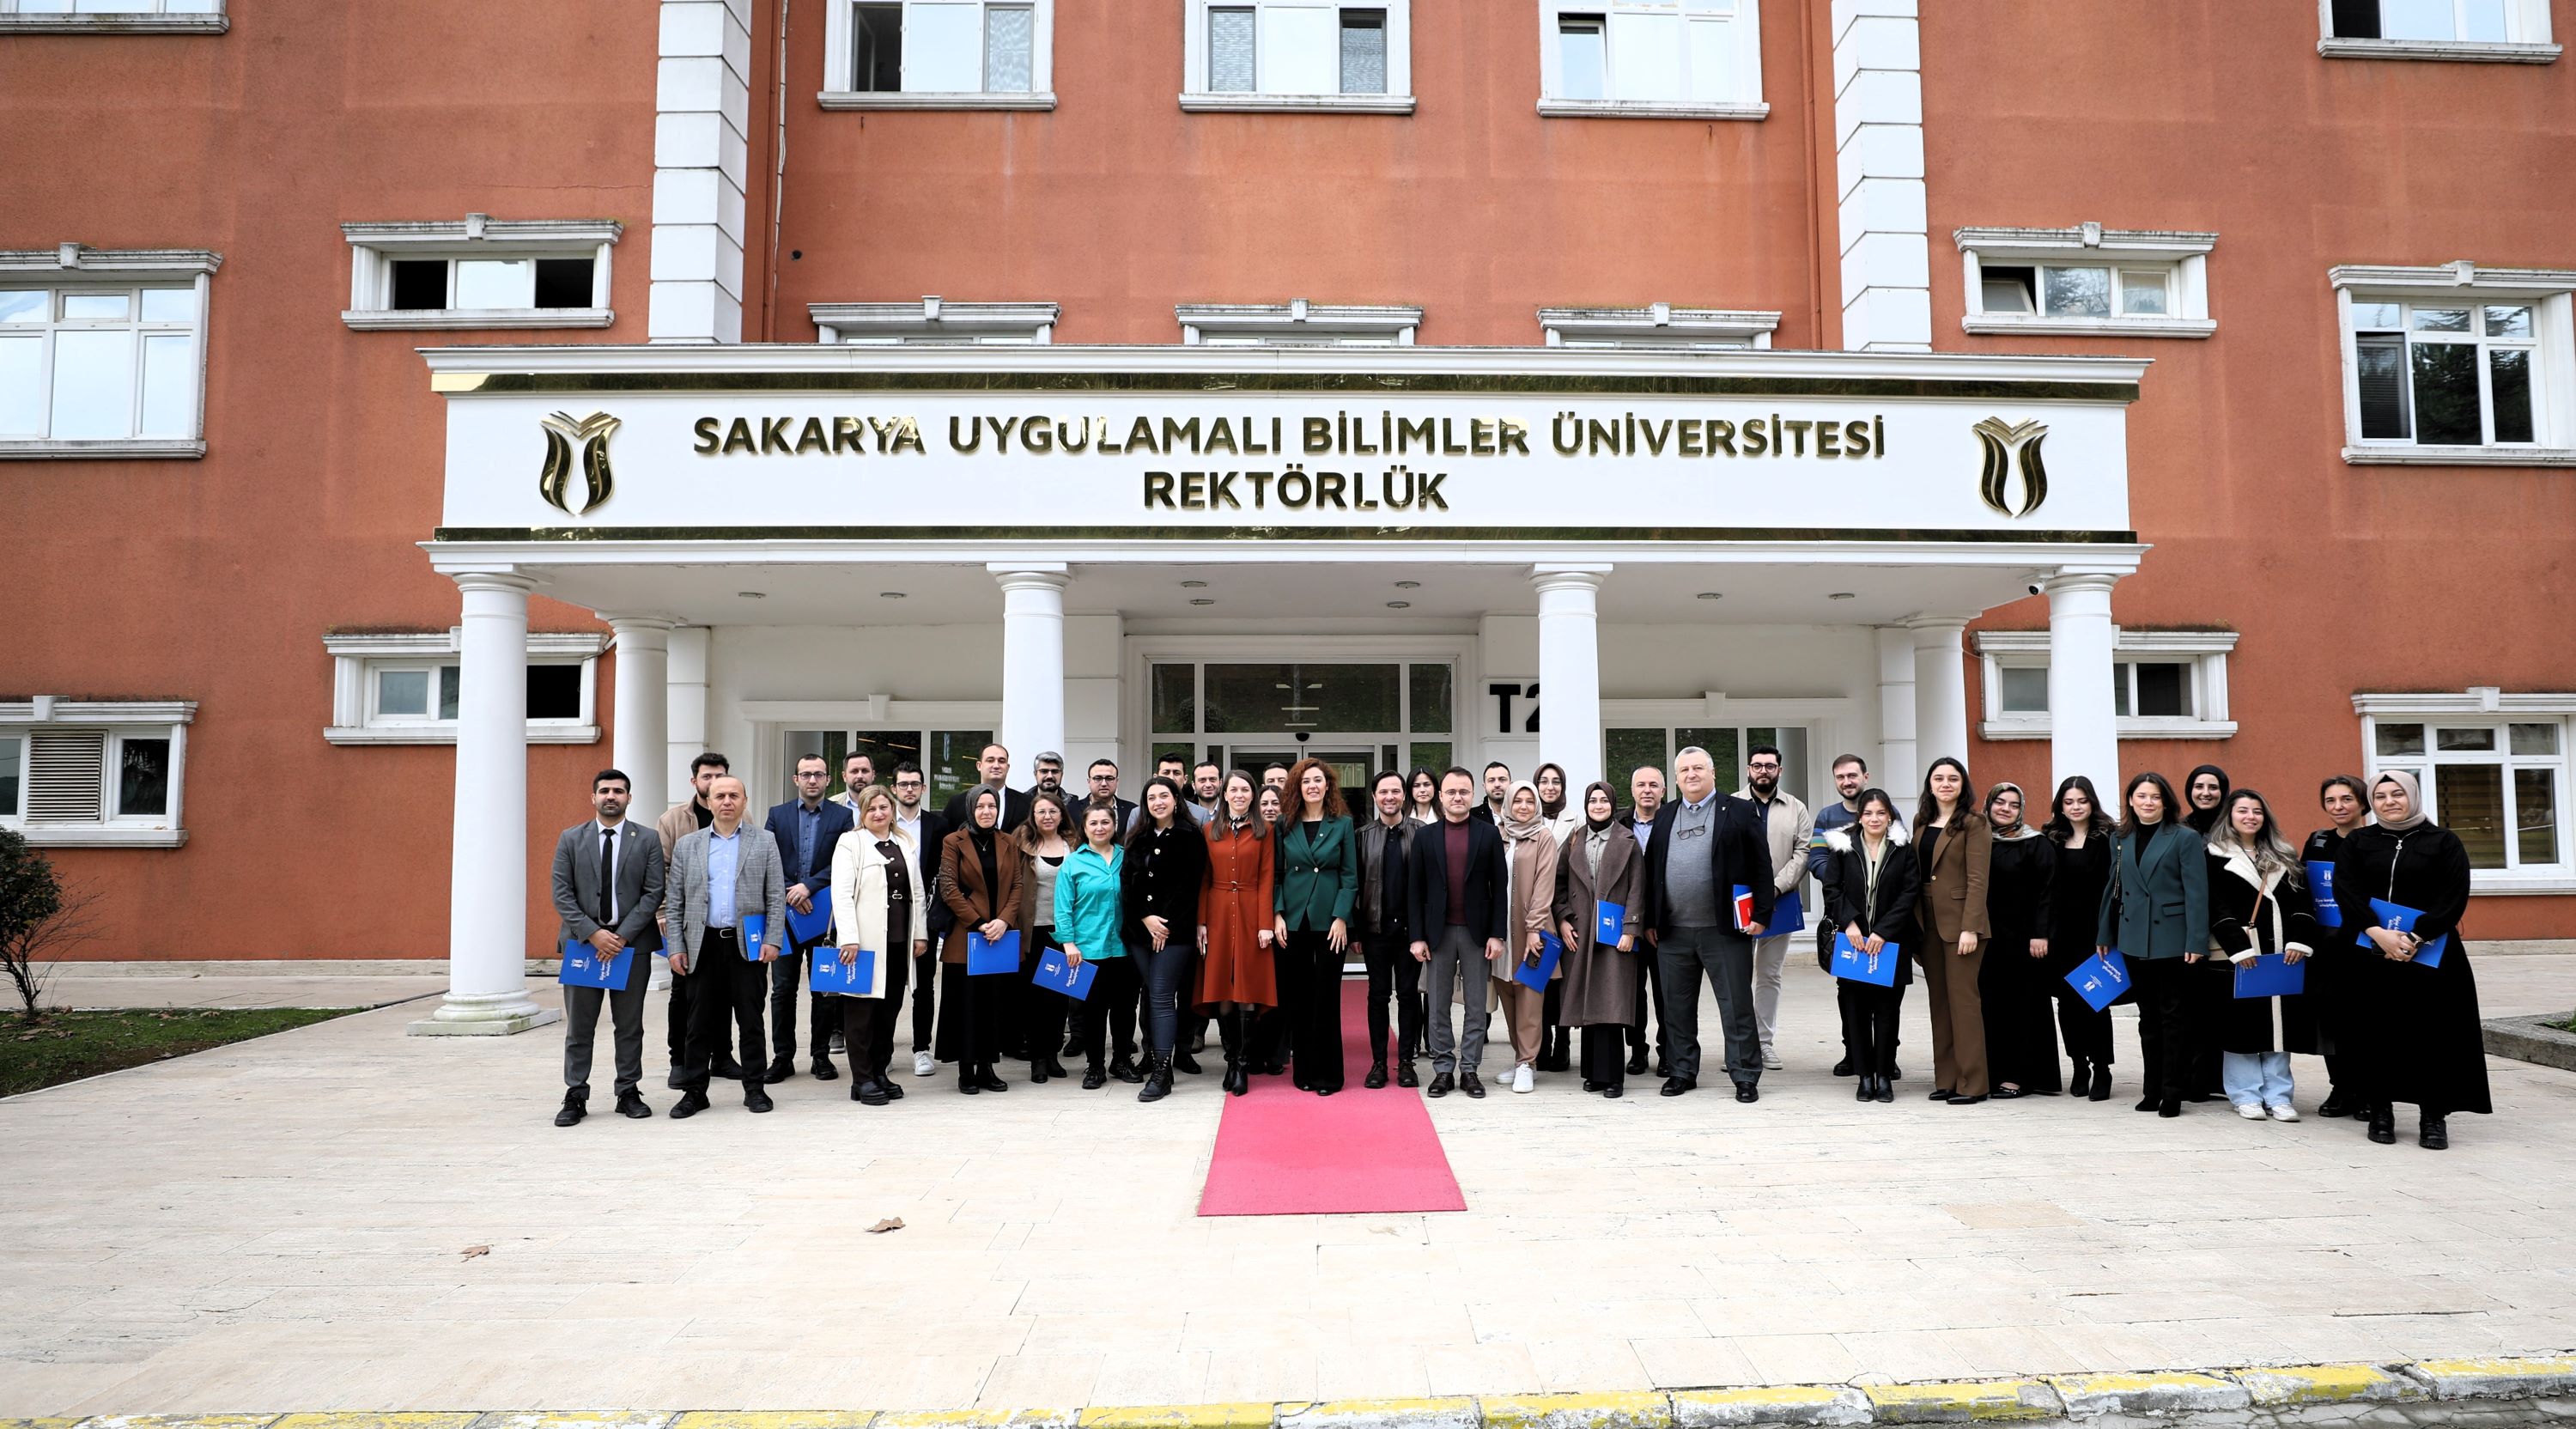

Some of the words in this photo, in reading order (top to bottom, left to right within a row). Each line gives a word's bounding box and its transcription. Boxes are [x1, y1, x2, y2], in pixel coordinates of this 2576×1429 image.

[694, 416, 926, 454] SAKARYA
[949, 416, 1281, 455] UYGULAMALI
[1303, 410, 1530, 455] BİLİMLER
[1552, 411, 1886, 457] ÜNİVERSİTESİ
[1144, 464, 1449, 510] REKTÖRLÜK
